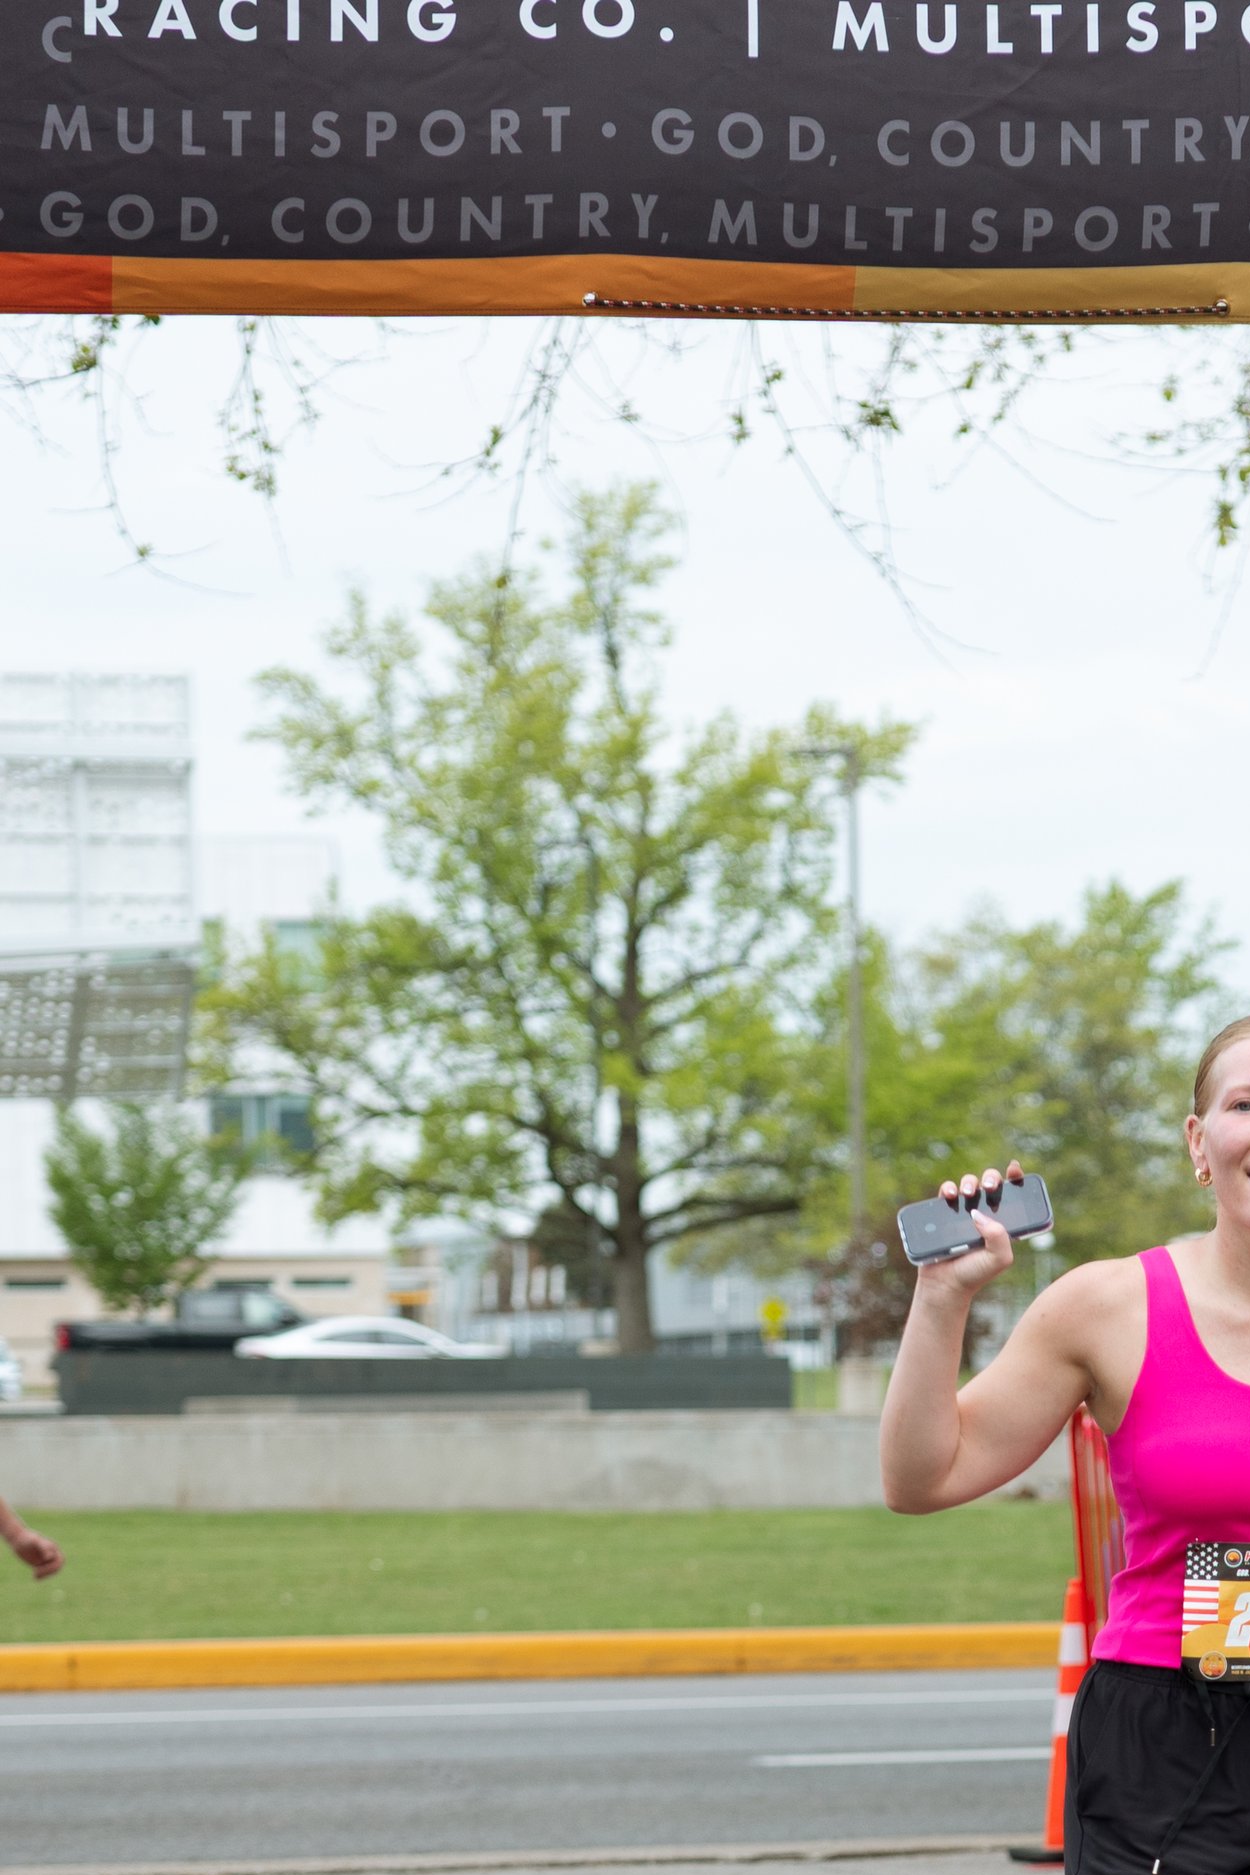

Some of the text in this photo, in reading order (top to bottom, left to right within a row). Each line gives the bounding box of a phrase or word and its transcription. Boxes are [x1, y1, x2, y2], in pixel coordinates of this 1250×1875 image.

[84, 0, 456, 42] RACING
[520, 0, 673, 41] CO.
[41, 104, 570, 157] MULTISPORT
[652, 108, 836, 167] GOD,
[40, 191, 229, 246] GOD,
[272, 192, 668, 244] COUNTRY,
[708, 199, 1219, 252] MULTISPORT
